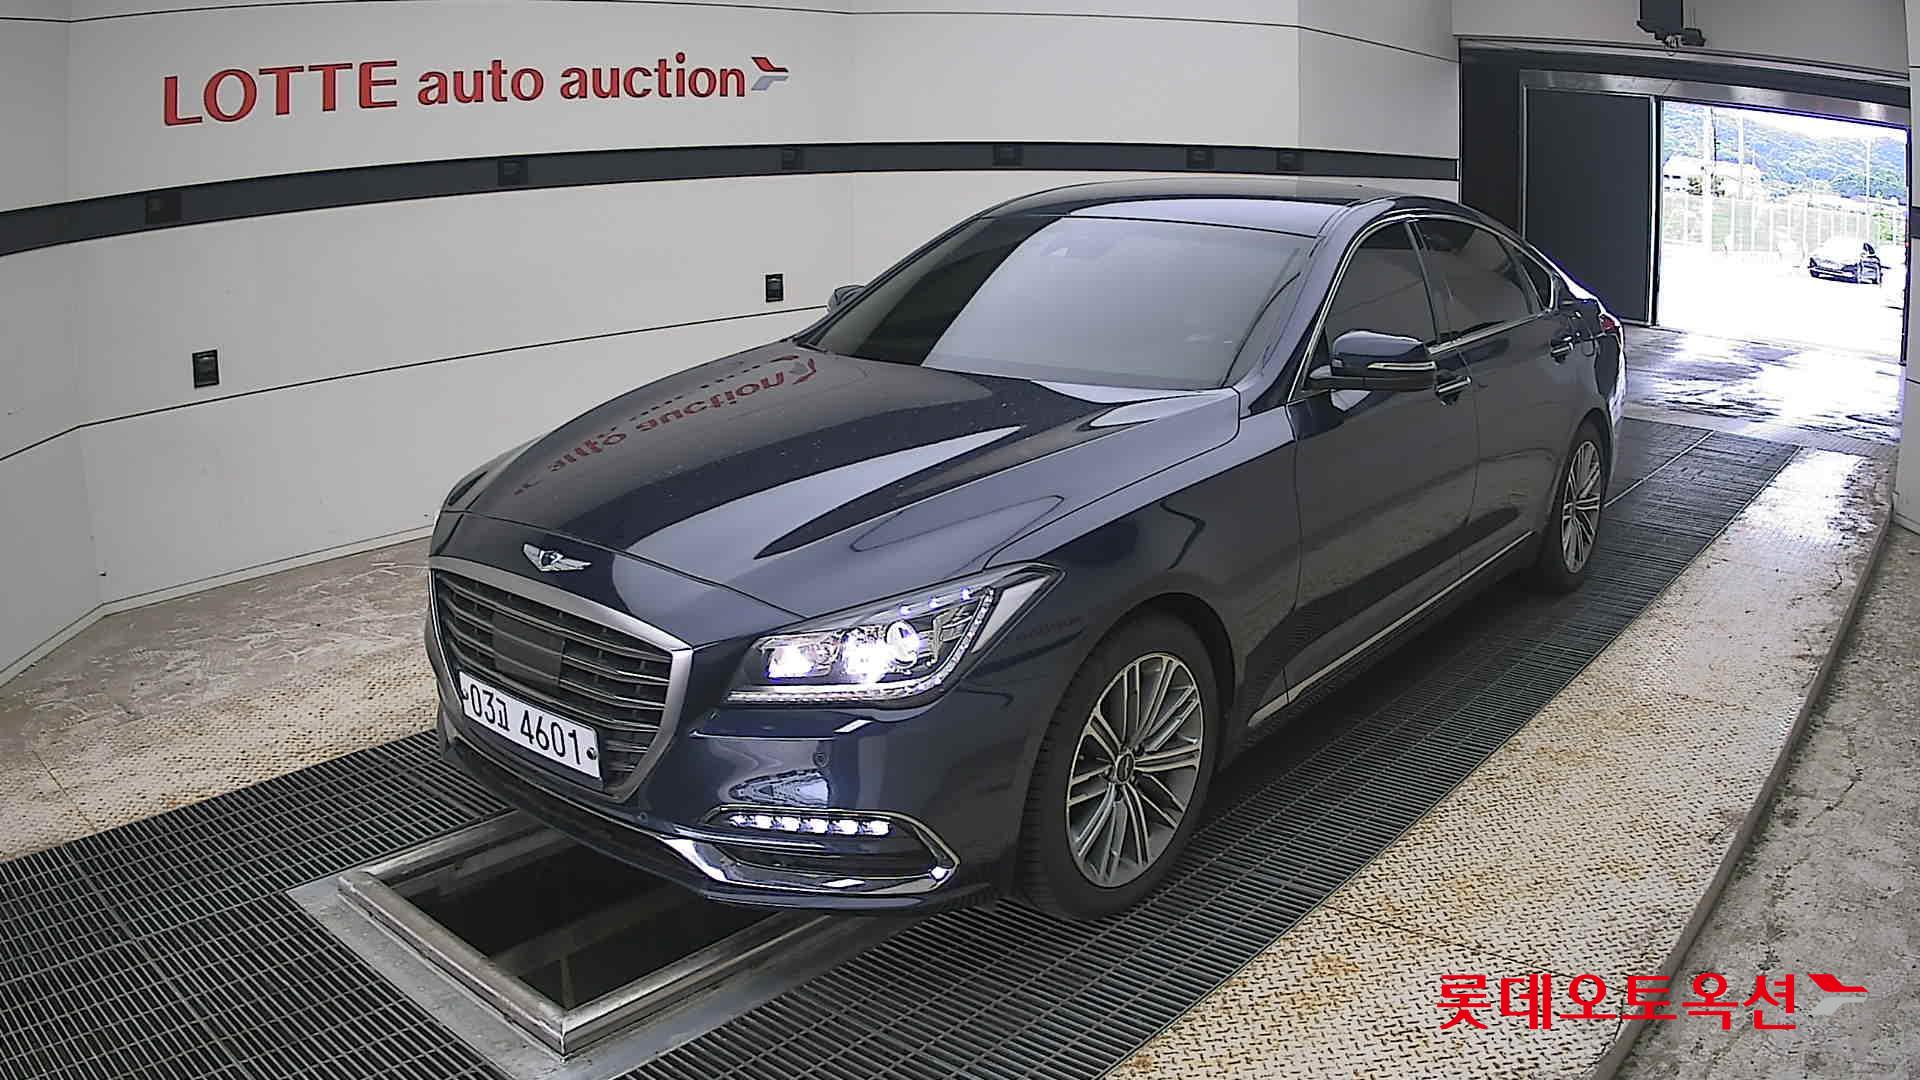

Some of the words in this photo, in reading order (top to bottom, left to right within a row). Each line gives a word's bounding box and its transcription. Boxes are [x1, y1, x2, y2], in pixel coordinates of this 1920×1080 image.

[163, 60, 398, 126] LOTTE
[417, 58, 545, 106] auto
[559, 52, 747, 101] auction
[469, 683, 510, 733] 03고
[520, 709, 582, 766] 4601
